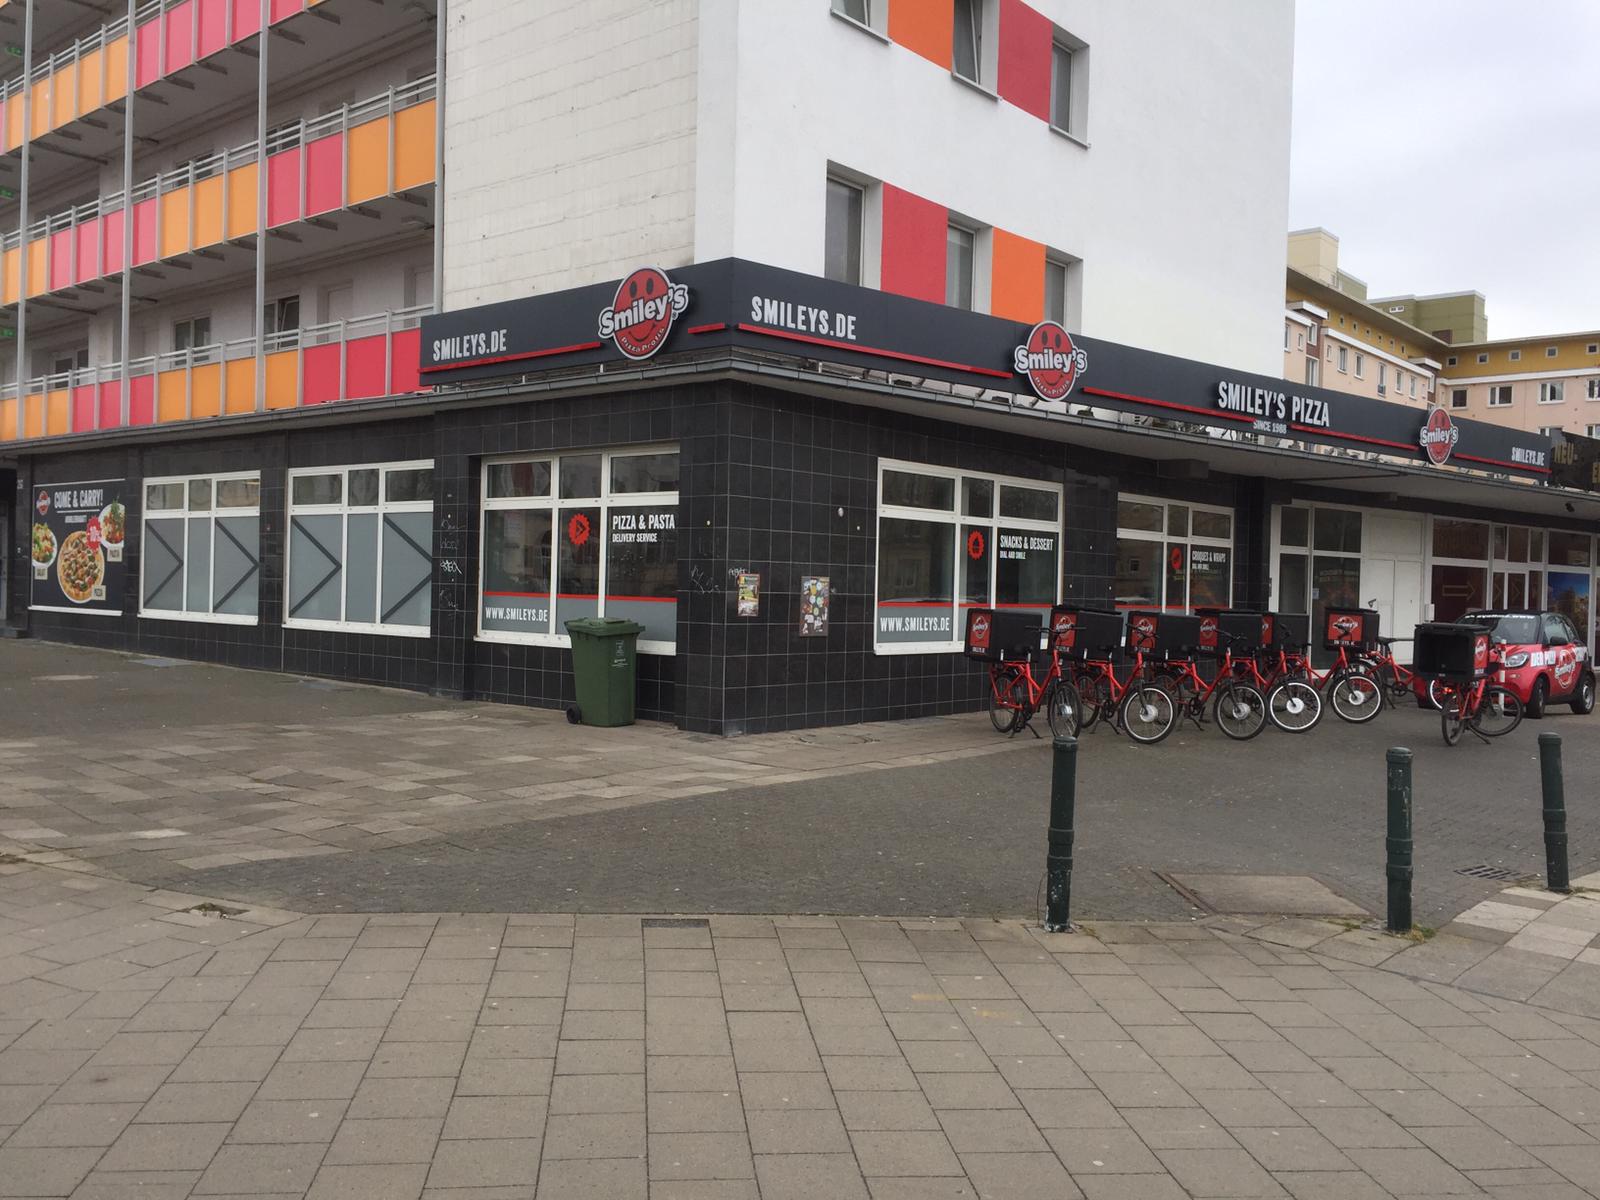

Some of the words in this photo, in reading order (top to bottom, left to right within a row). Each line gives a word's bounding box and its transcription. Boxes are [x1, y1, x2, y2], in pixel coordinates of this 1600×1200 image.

[600, 287, 686, 336] Smiley's
[751, 295, 857, 341] SMILEYS.DE
[432, 329, 507, 361] SMILEYS.DE
[1017, 347, 1086, 374] Smiley's
[1218, 380, 1286, 419] SMILEY'S
[1291, 395, 1330, 427] PIZZA
[1252, 419, 1272, 432] SINCE
[1421, 427, 1457, 444] Smiley's
[1511, 446, 1545, 466] SMILEYS.DE
[72, 490, 78, 508] &
[612, 515, 637, 530] PIZZA
[638, 514, 647, 530] &
[648, 513, 676, 530] PASTA
[612, 532, 636, 543] DELIVERY
[635, 532, 658, 543] SERVICE
[1000, 534, 1023, 549] SNACKS
[1023, 536, 1029, 549] &
[1029, 536, 1054, 551] DESSERT
[485, 607, 549, 622] WWW.SMILEYS.DE
[880, 616, 950, 632] WWW.SMILEYS.DE
